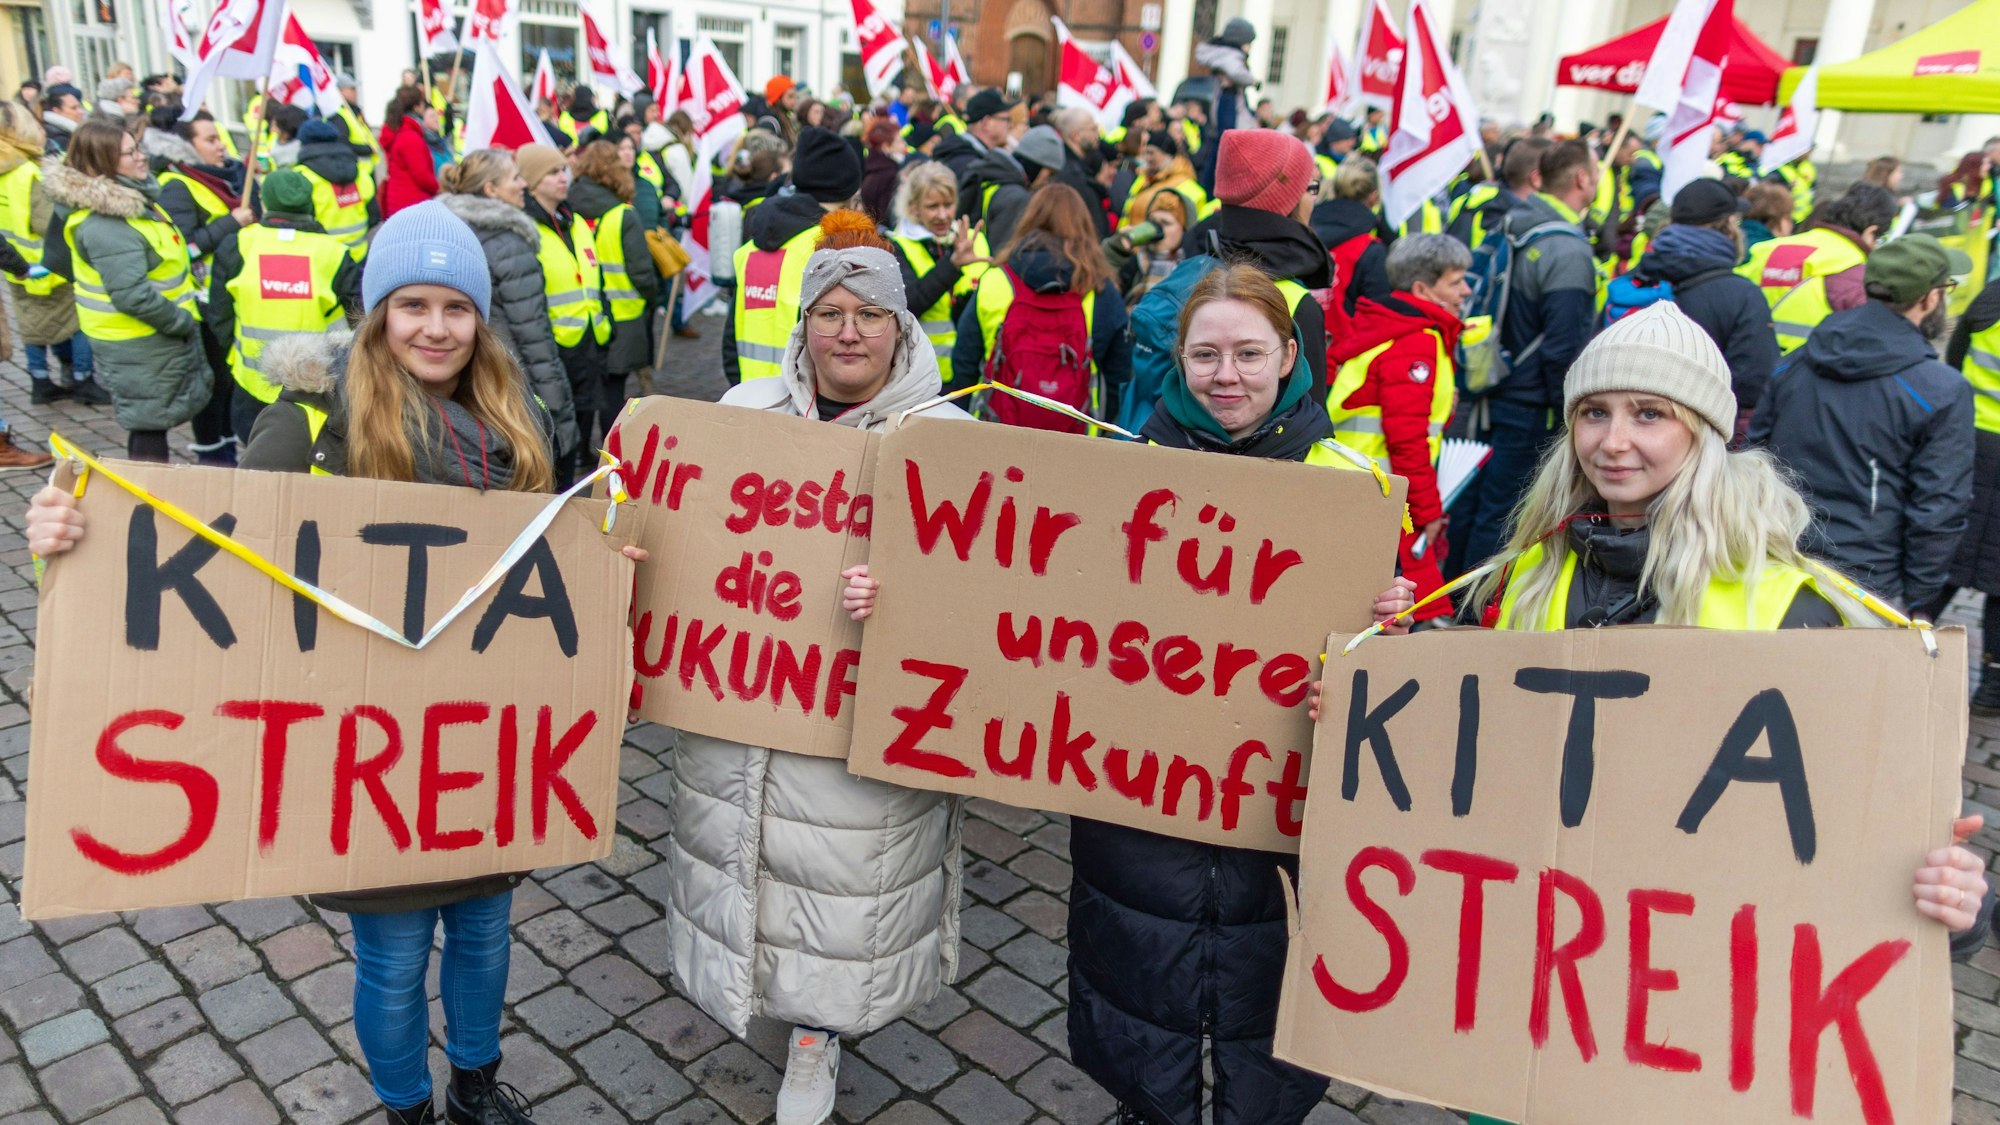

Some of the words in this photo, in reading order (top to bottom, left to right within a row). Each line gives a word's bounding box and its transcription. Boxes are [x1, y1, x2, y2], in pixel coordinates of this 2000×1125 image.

[262, 279, 310, 295] ver.di
[745, 285, 777, 300] ver.di
[606, 423, 703, 511] Wir
[725, 469, 873, 541] gesta
[904, 458, 1081, 577] Wir
[1121, 488, 1304, 604] für
[126, 504, 579, 658] KITA
[714, 550, 803, 622] die
[629, 603, 861, 720] UKUNF
[996, 611, 1311, 708] unsere
[68, 699, 599, 877] STREIK
[883, 658, 1308, 838] Zukunft
[1341, 667, 1817, 865] KITA
[1312, 845, 1912, 1125] STREIK
